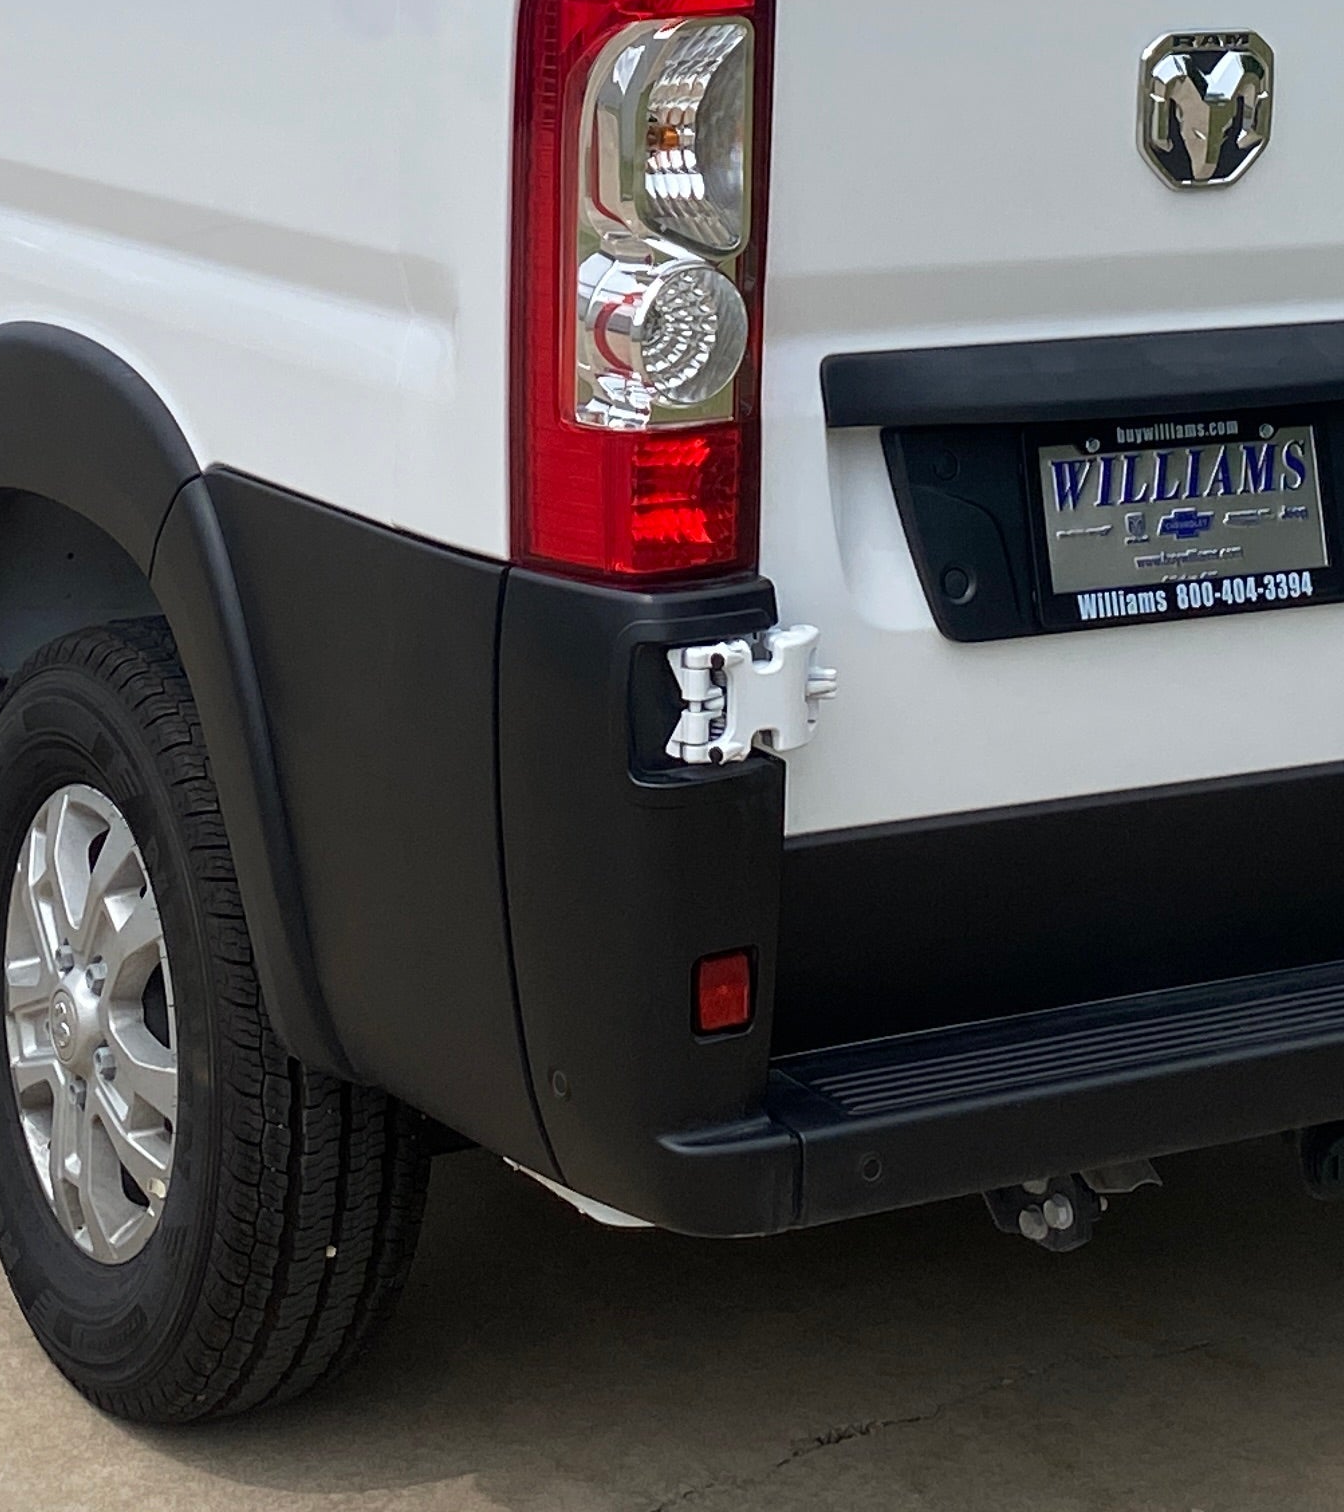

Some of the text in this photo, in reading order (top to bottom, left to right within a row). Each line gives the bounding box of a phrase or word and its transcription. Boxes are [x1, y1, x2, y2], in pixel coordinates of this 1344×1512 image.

[1116, 420, 1239, 444] buywilliams.com
[1048, 439, 1307, 512] WILLIAMS
[1077, 570, 1313, 621] Williams 800-404-3394
